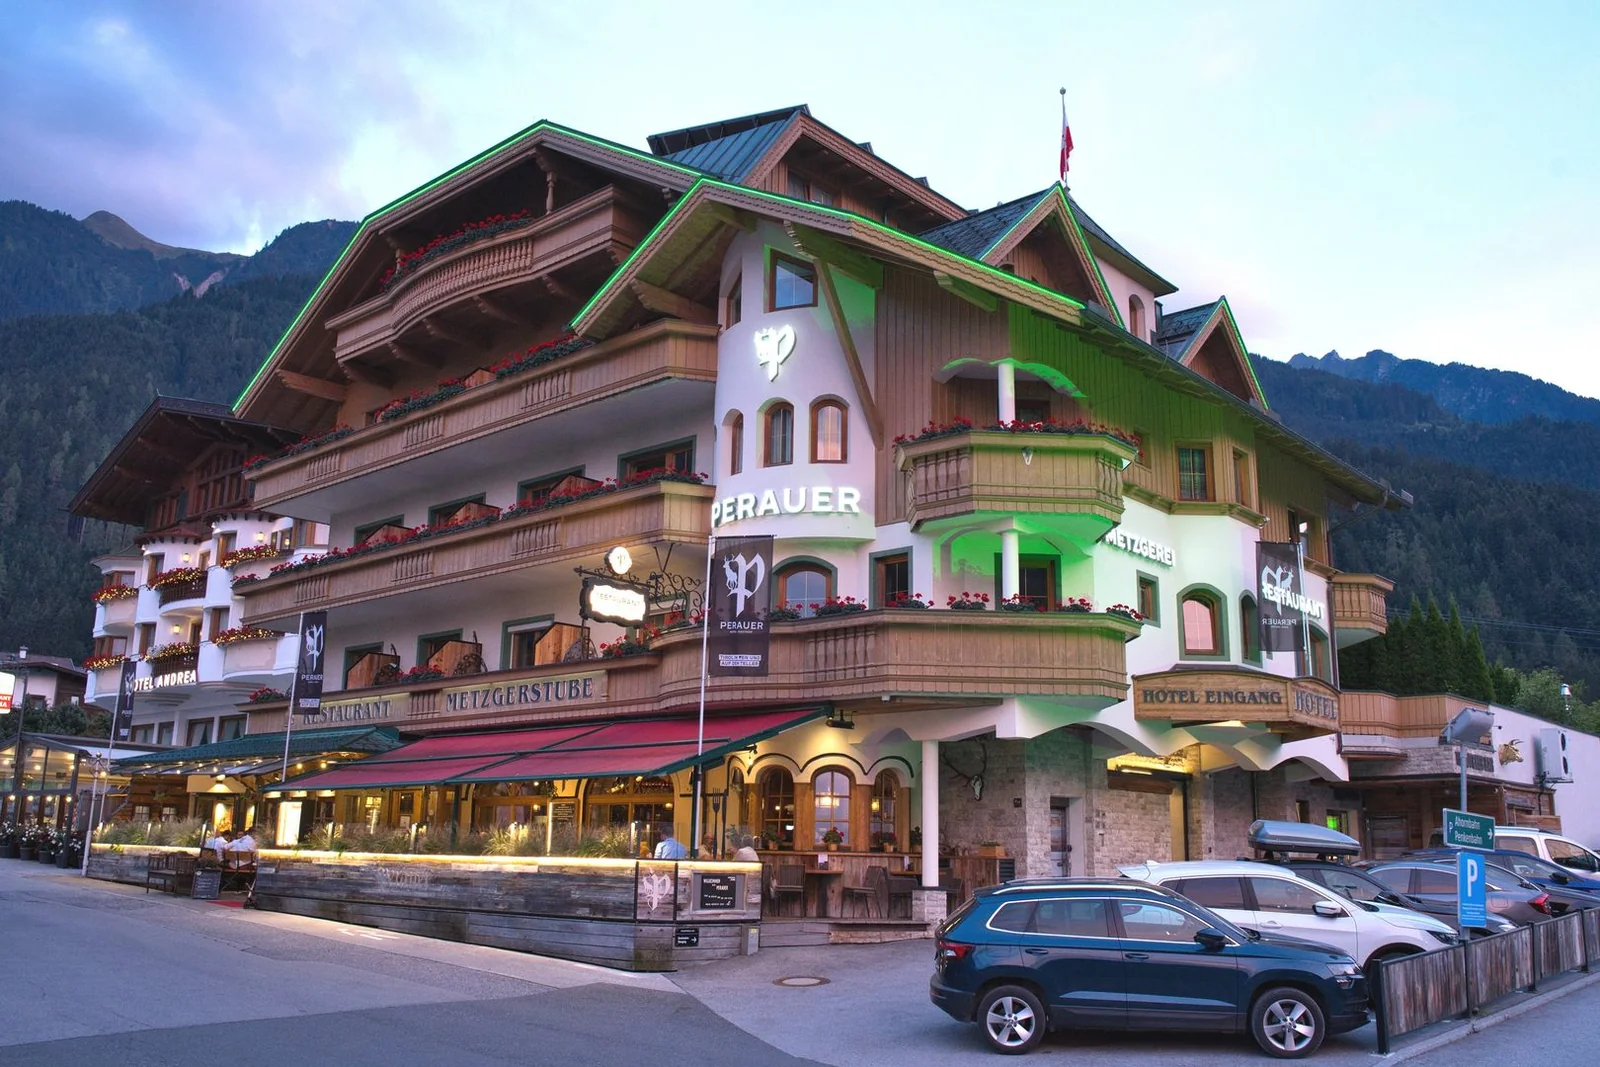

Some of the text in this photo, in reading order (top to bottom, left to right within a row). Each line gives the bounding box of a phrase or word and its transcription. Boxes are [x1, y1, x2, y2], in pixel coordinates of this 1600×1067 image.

[711, 486, 861, 528] PERAUER
[1105, 527, 1177, 567] METZGEREI
[1261, 582, 1326, 620] RESTAURANT
[720, 621, 764, 630] PERAUER
[157, 670, 196, 689] ANDREA
[447, 677, 593, 712] METZGERSTUBE
[1143, 689, 1282, 705] HOTEL EINGANG
[1294, 690, 1337, 719] HOTEL
[1455, 815, 1480, 830] Ahornbahn
[1455, 830, 1483, 845] Penkenbahn
[1467, 859, 1478, 898] P
